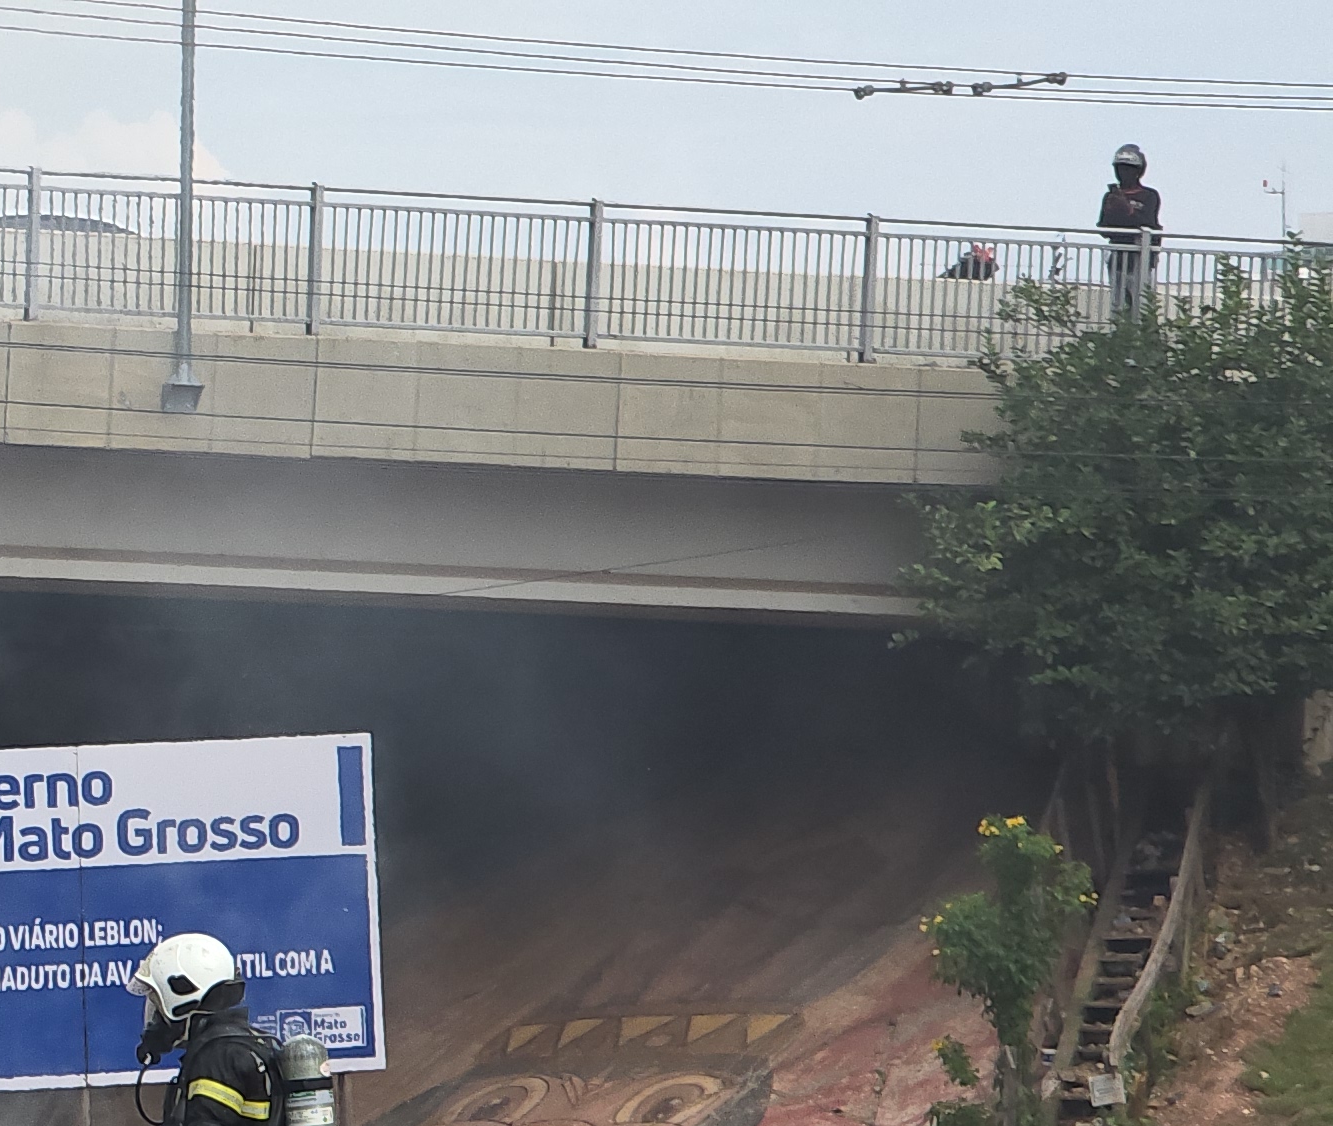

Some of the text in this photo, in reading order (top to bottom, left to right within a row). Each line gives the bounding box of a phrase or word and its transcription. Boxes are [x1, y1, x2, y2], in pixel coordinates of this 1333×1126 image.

[116, 808, 300, 857] Grosso
[8, 917, 79, 950] VIÁRIO
[74, 962, 106, 989] DA
[275, 950, 317, 977] COM
[320, 949, 335, 974] A
[314, 1018, 348, 1031] Mato
[314, 1031, 361, 1044] Grosso
